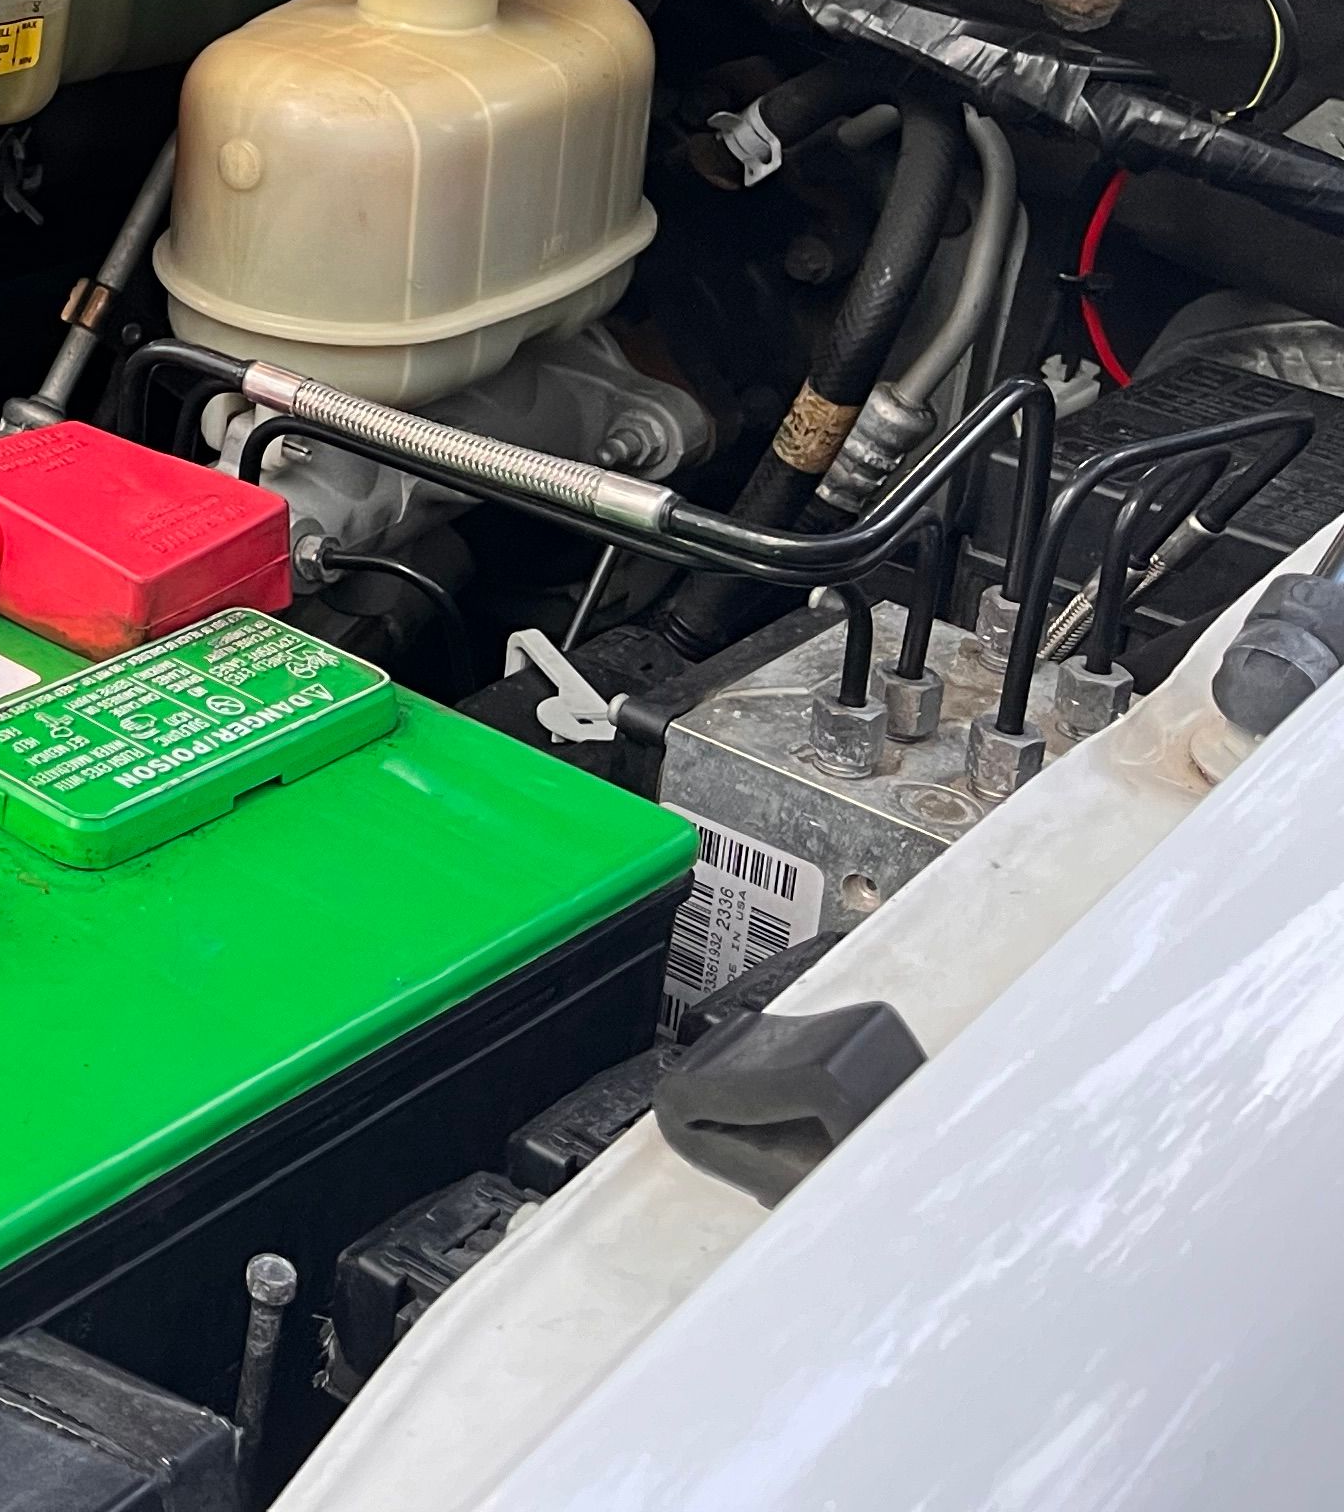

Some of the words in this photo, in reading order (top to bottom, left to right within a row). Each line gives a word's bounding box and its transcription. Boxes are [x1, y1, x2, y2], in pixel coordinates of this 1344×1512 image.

[110, 693, 313, 789] DANGER/POISON
[716, 886, 735, 931] 2336
[735, 891, 746, 921] USA
[731, 931, 741, 952] IN
